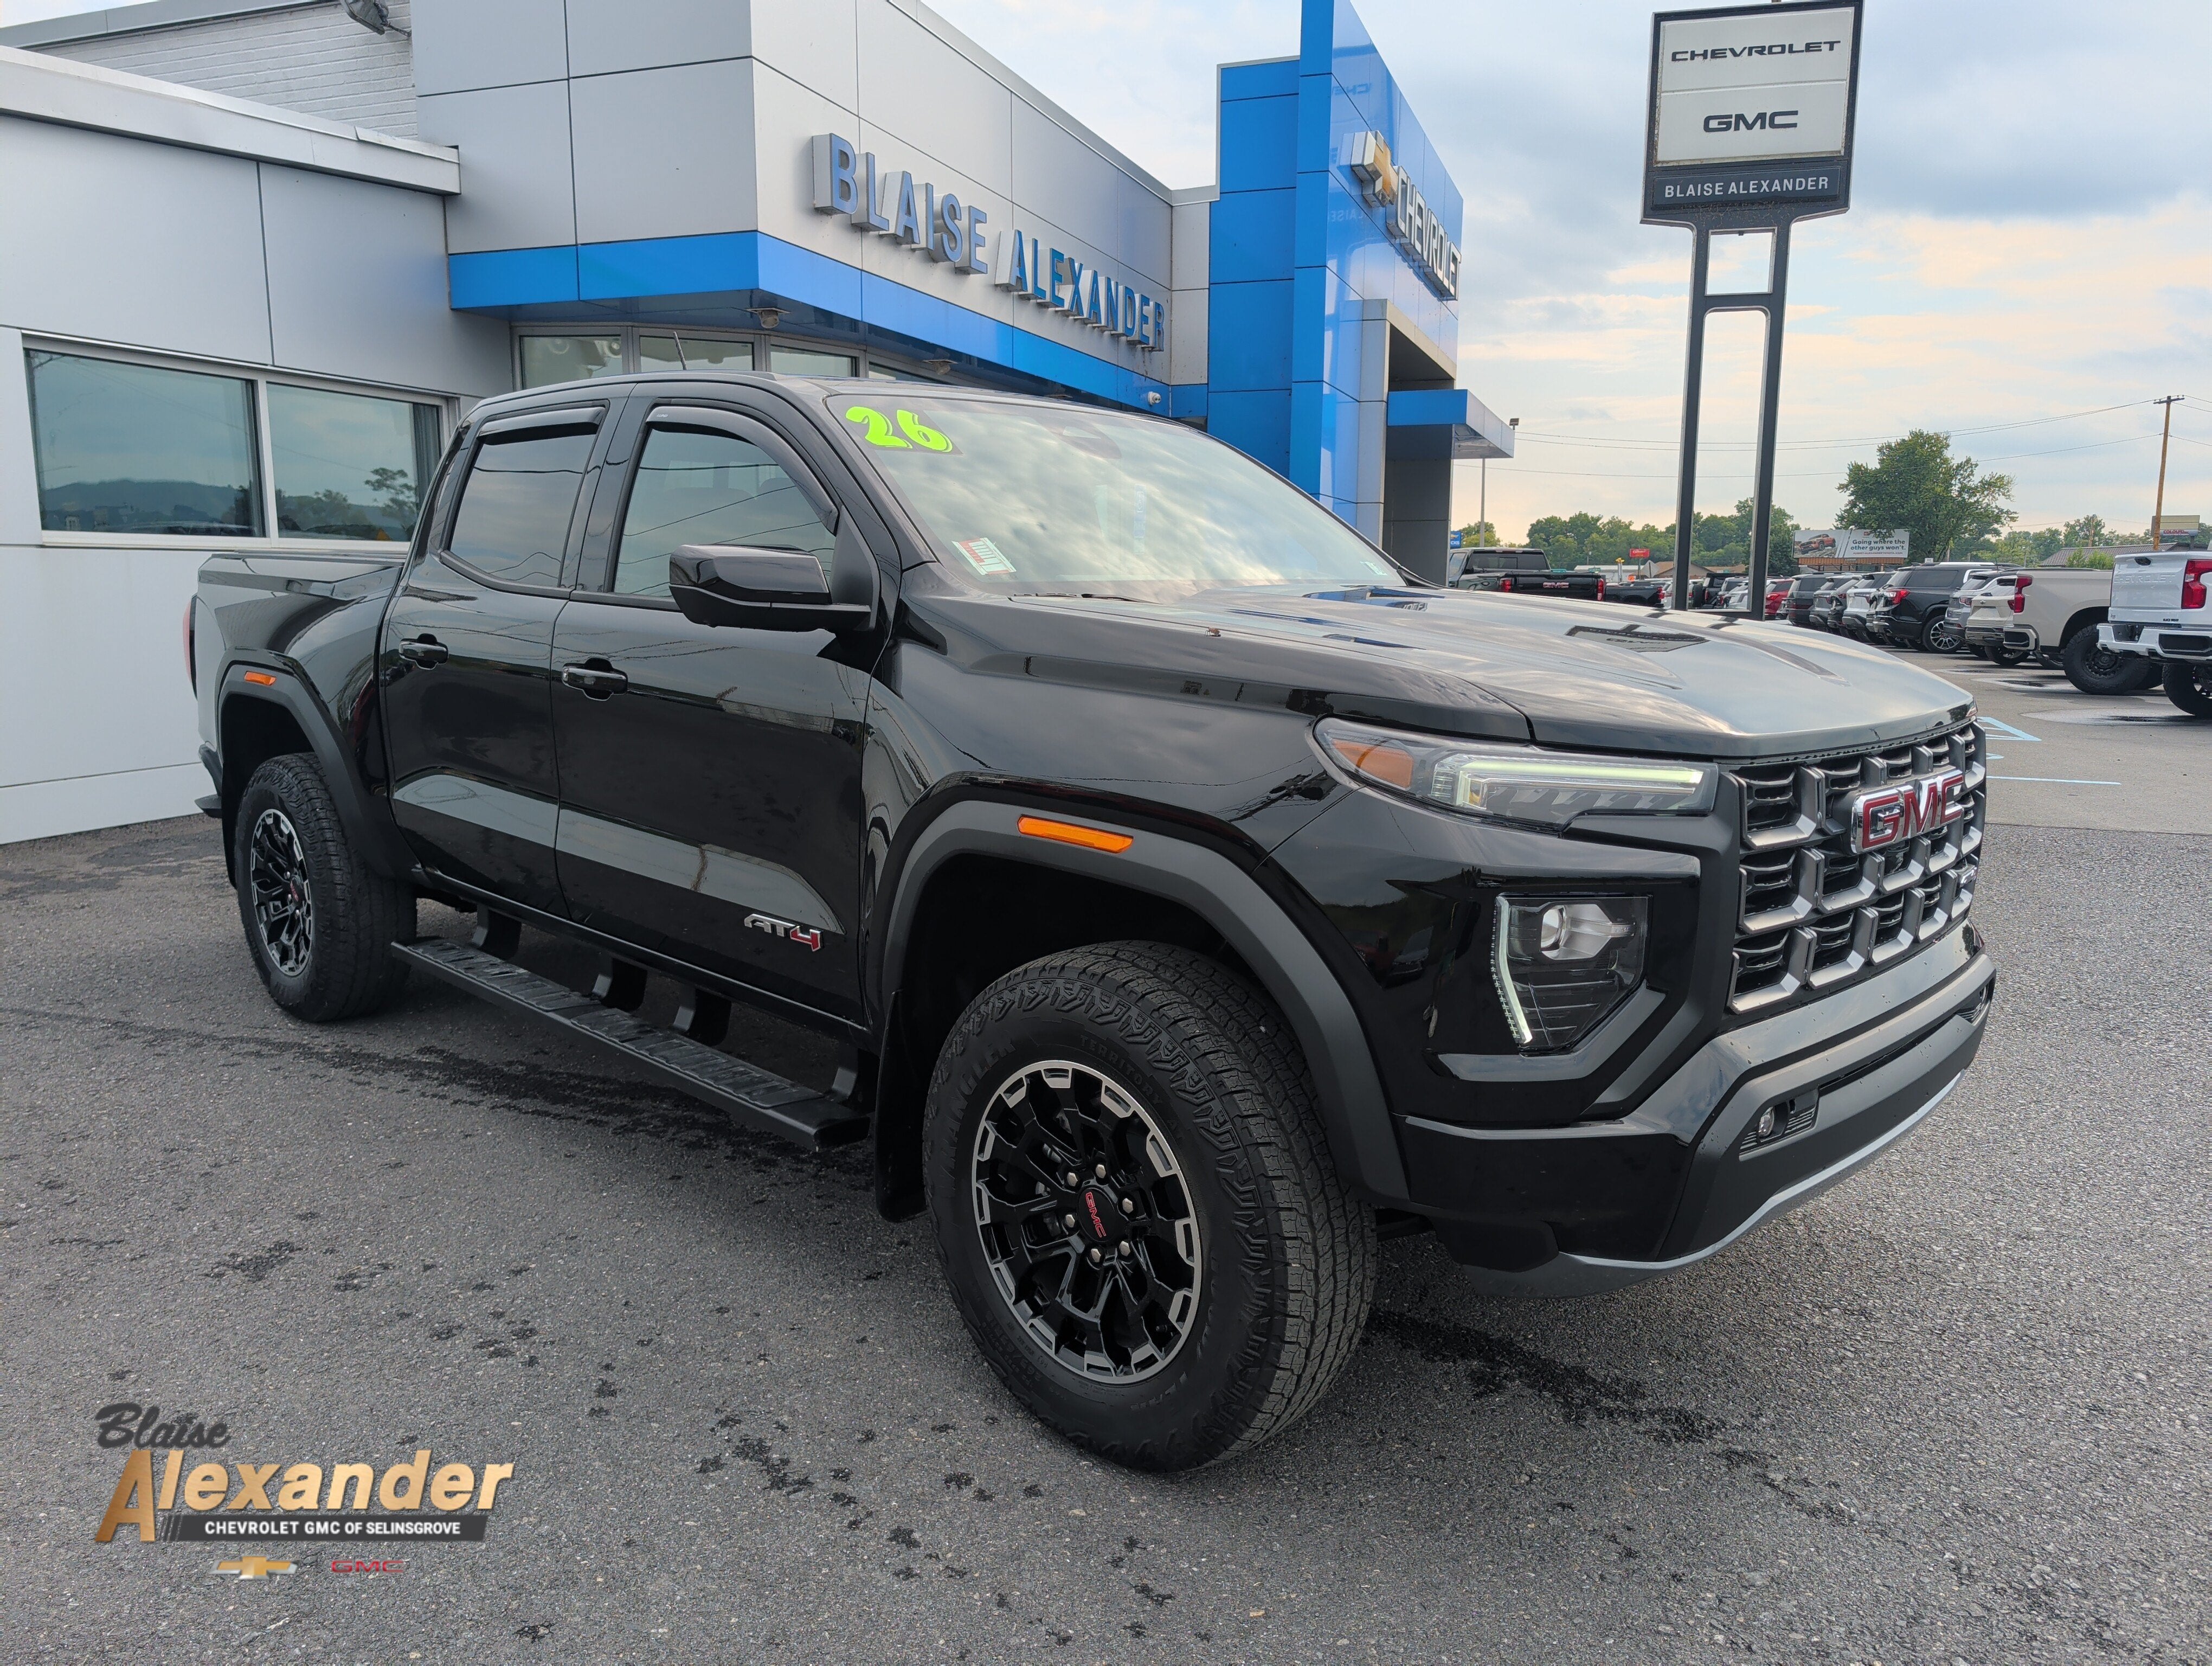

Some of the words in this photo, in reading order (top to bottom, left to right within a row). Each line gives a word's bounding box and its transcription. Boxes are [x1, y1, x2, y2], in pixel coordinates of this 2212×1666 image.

[1671, 41, 1841, 62] CHEVROLET
[1703, 110, 1798, 133] GMC
[1664, 182, 1724, 198] BLAISE
[1728, 176, 1829, 195] ALEXANDER
[827, 132, 988, 275] BLAISE
[1009, 228, 1165, 353] ALEXANDER
[1396, 165, 1462, 301] CHEVROLET
[845, 406, 953, 452] 26
[2114, 574, 2176, 583] CHEVROLET
[1851, 770, 1965, 854] GMC
[744, 913, 822, 952] AT4
[1080, 1034, 1163, 1105] TERRITORY
[1085, 1191, 1107, 1238] GMC
